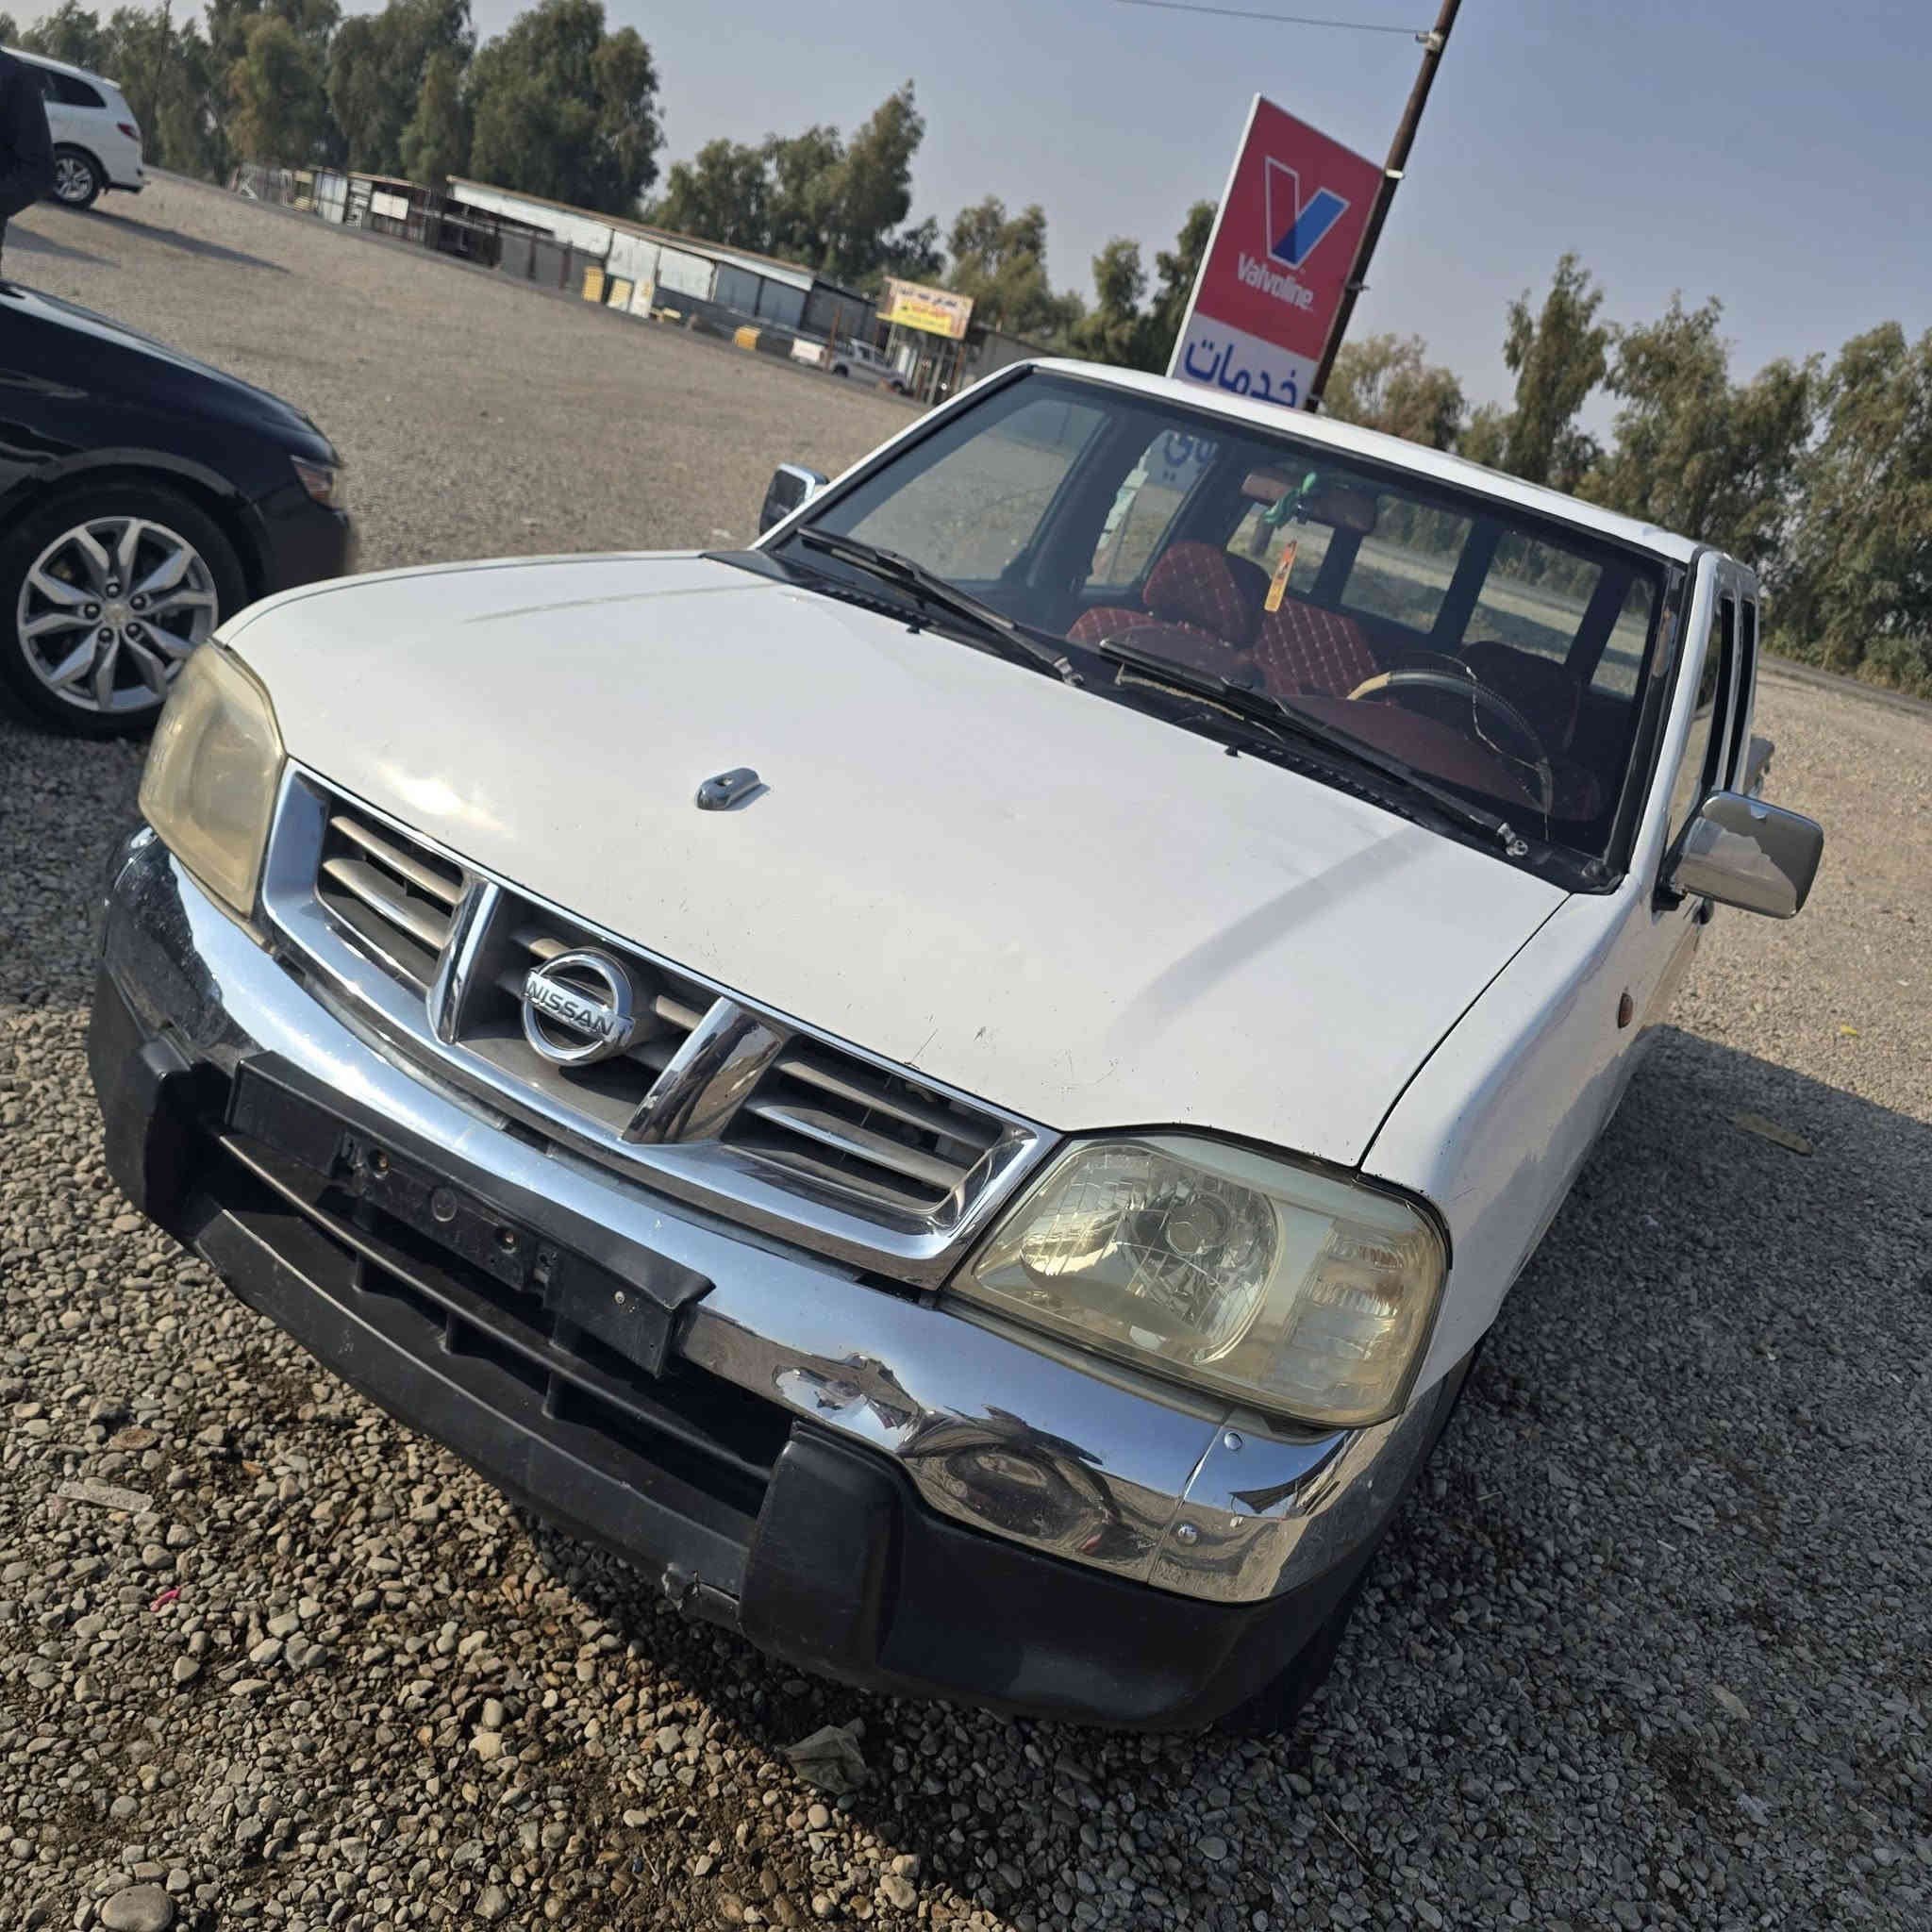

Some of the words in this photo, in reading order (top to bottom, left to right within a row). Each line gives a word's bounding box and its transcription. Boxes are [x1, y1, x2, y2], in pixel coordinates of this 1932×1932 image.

[1237, 251, 1314, 310] Valvoline
[1184, 339, 1297, 408] خدمات
[526, 979, 615, 1037] NISSAN
